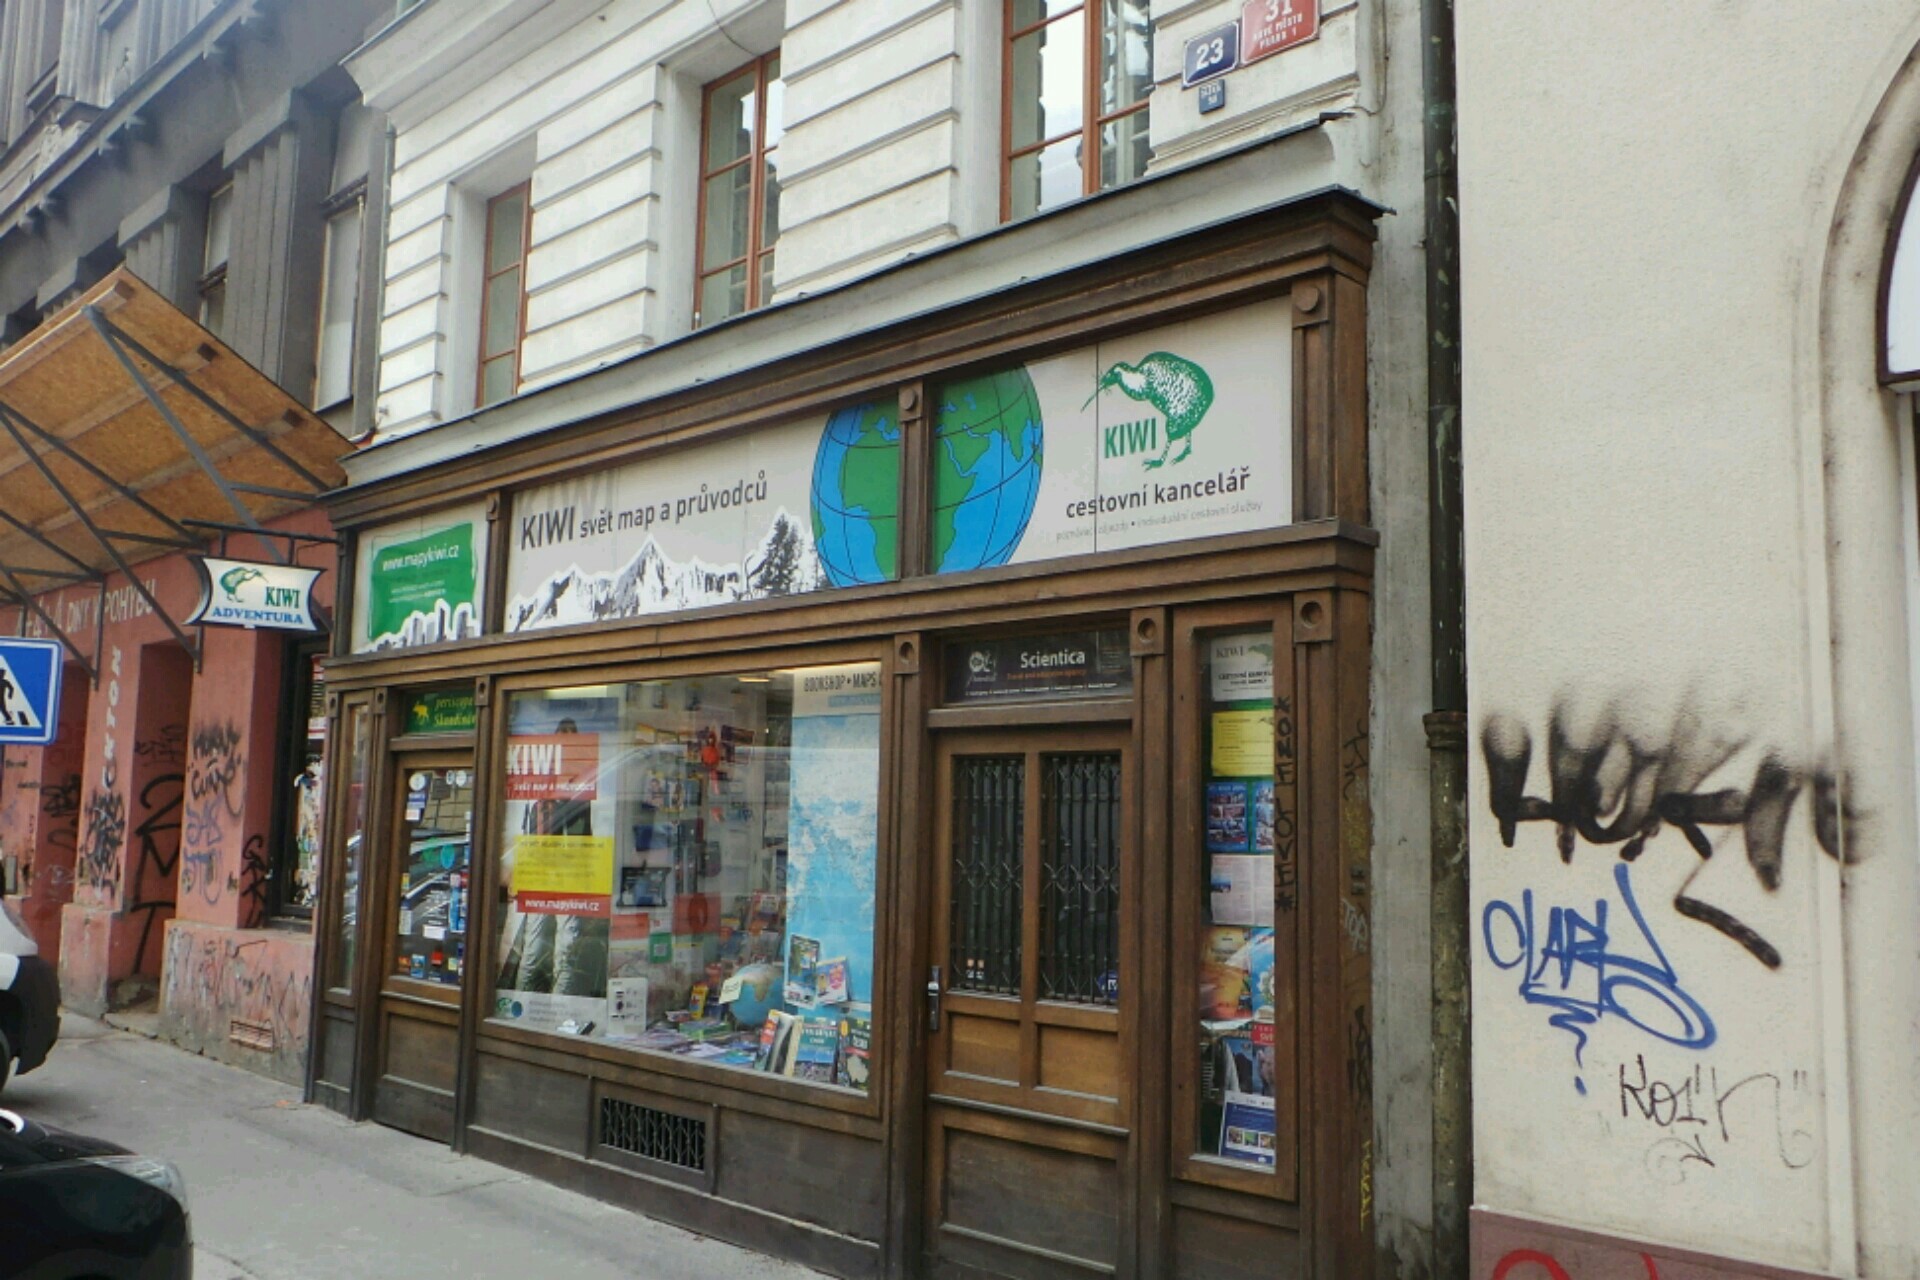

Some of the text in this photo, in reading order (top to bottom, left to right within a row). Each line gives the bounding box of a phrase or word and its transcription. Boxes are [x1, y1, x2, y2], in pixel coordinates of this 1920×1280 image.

[1265, 0, 1293, 22] 31
[1196, 37, 1224, 71] 23
[1104, 417, 1158, 459] KIWI
[1066, 465, 1252, 519] cestovní kancelář
[521, 469, 768, 551] KIWI svět map a průvodců
[382, 543, 460, 571] www.mapykiwi.cz
[265, 586, 301, 609] KIWI
[212, 606, 304, 625] ADVENTURA
[1020, 648, 1086, 669] Scientica
[804, 671, 877, 692] BOOKSHOP MAPS
[506, 743, 562, 775] KIWI
[524, 898, 600, 912] www.mapykiwi.cz
